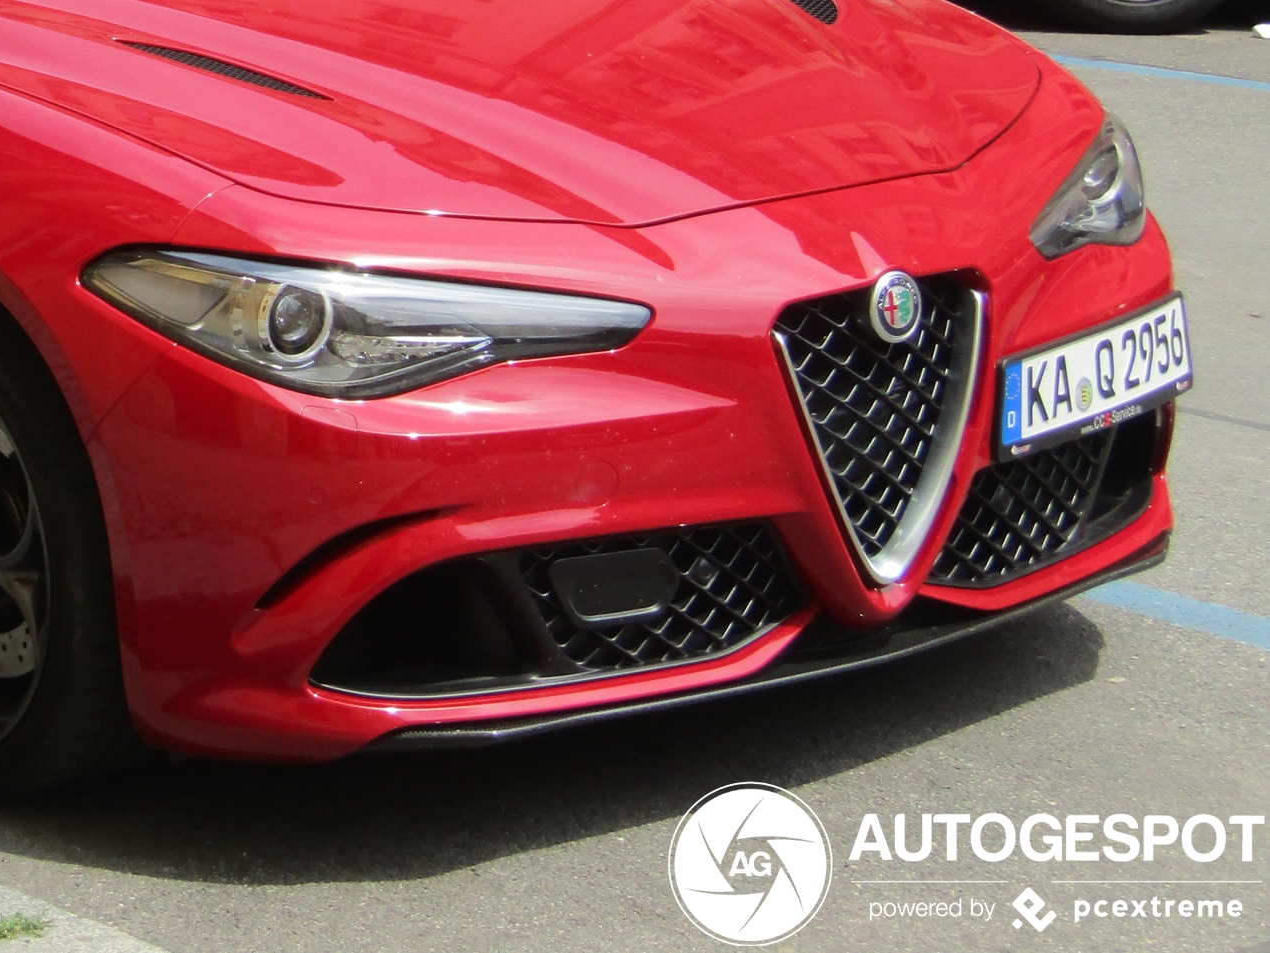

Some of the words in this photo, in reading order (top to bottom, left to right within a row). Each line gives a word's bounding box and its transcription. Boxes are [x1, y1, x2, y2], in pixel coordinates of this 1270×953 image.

[1027, 354, 1073, 427] KA
[1095, 338, 1116, 399] Q
[1121, 308, 1184, 391] 2956
[1007, 410, 1016, 428] D
